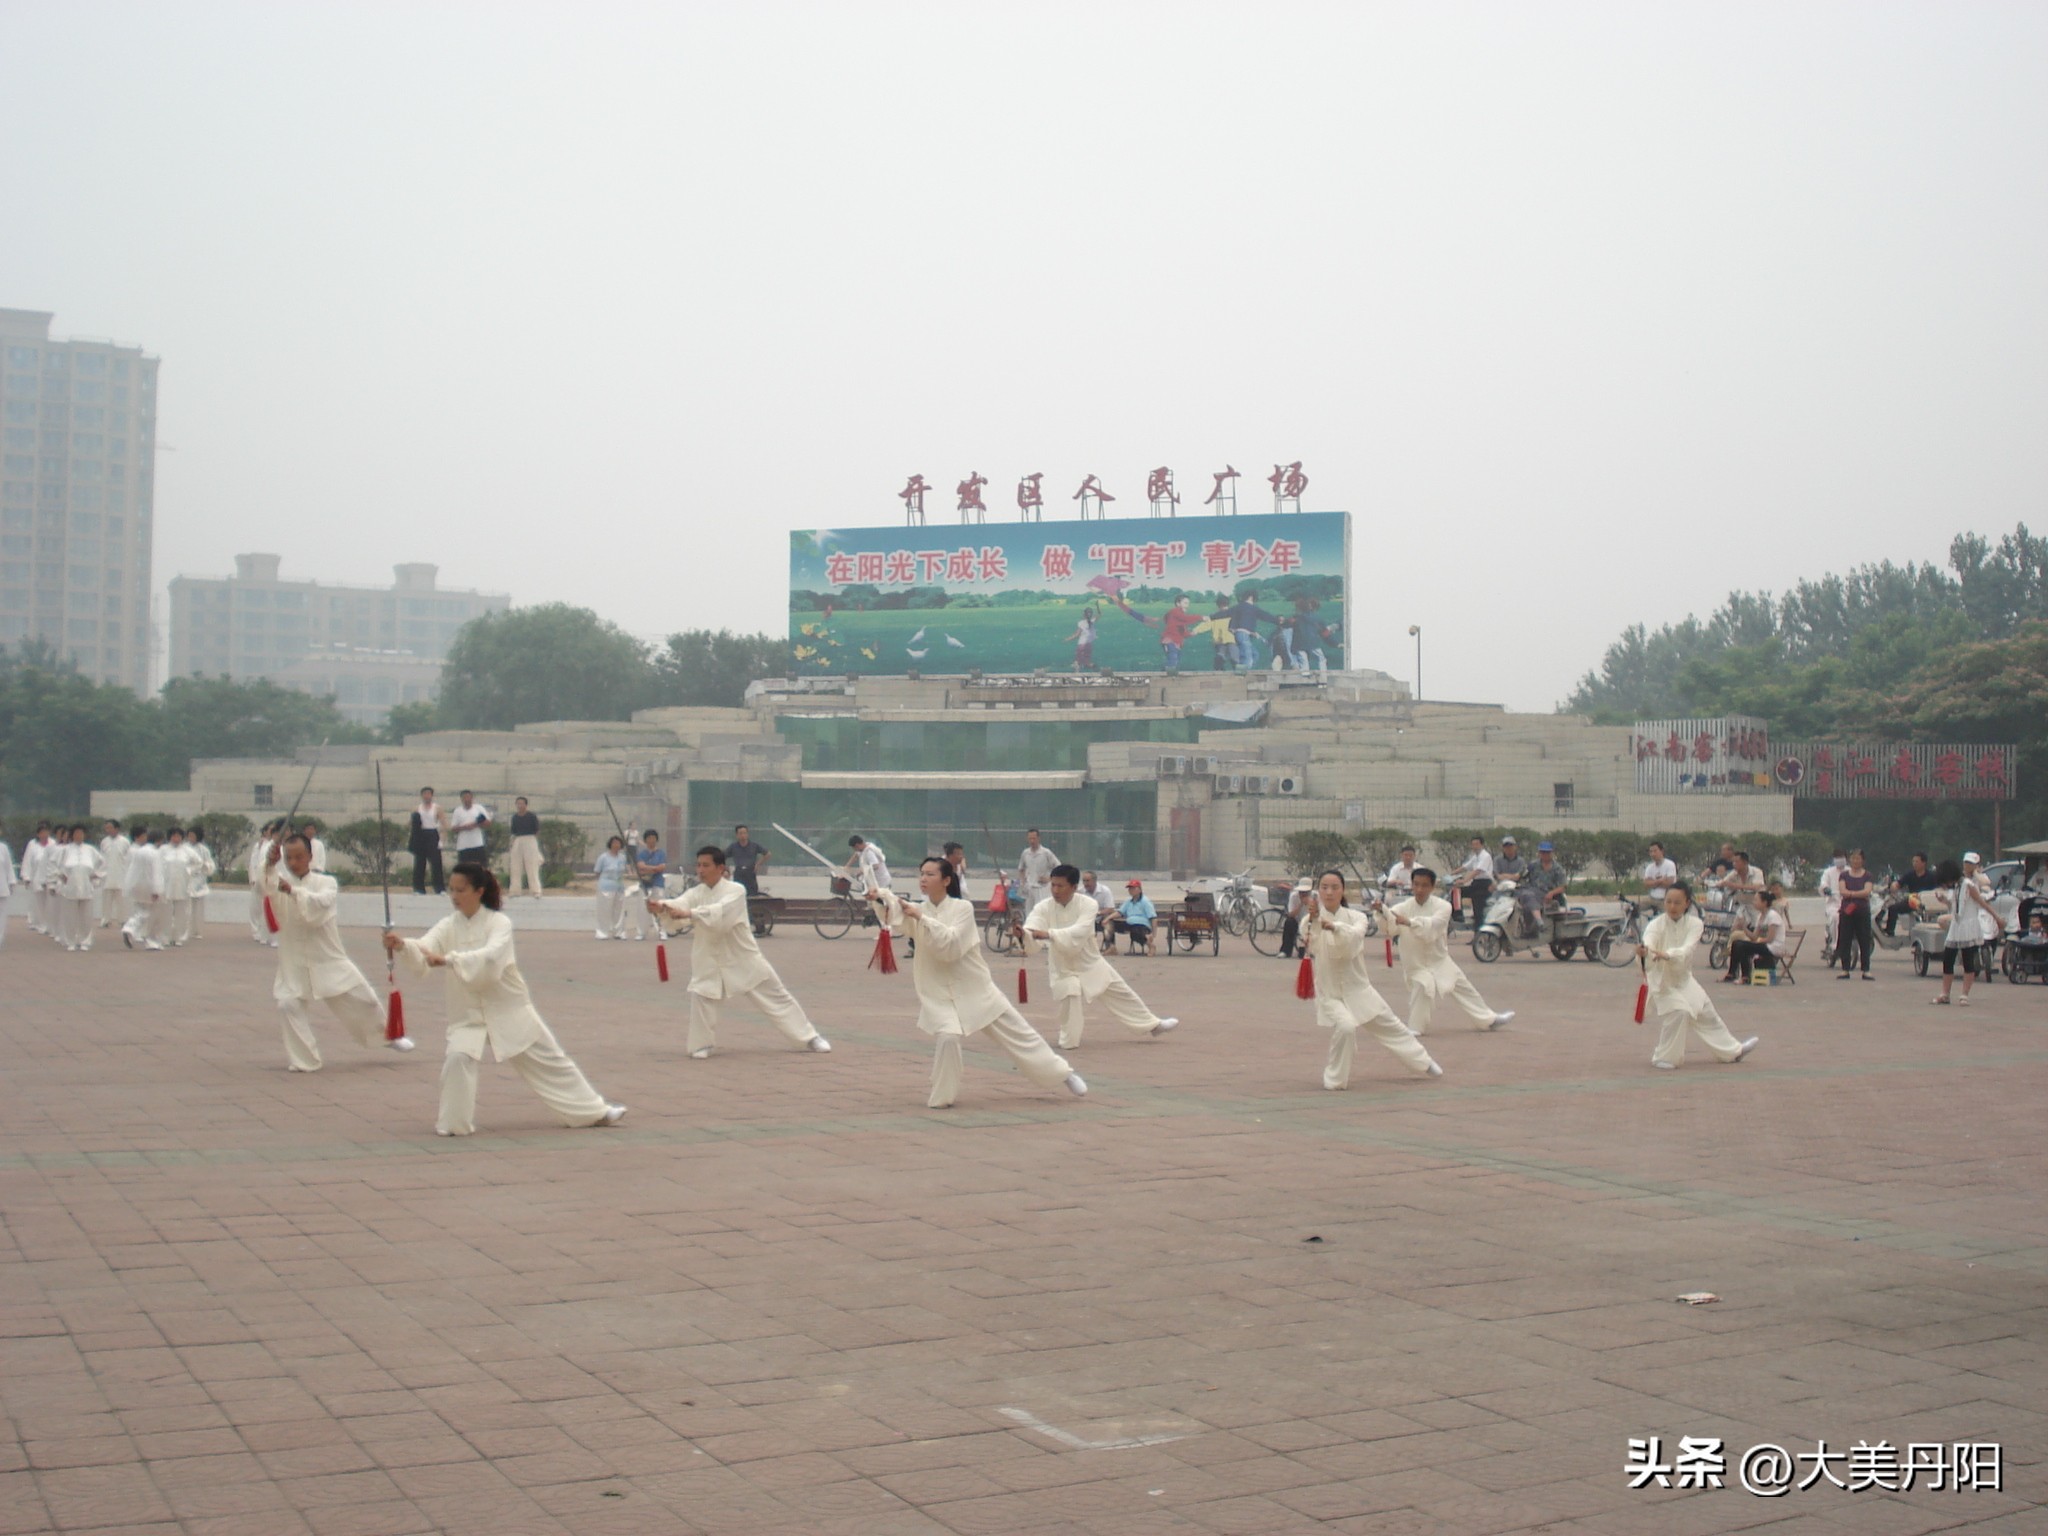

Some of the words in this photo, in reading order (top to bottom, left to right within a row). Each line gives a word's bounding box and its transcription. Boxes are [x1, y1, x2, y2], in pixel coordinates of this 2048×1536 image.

[898, 460, 1309, 511] 开发区人民广场
[826, 546, 1008, 584] 在阳光下成长
[1844, 747, 2009, 784] 江南客栈
